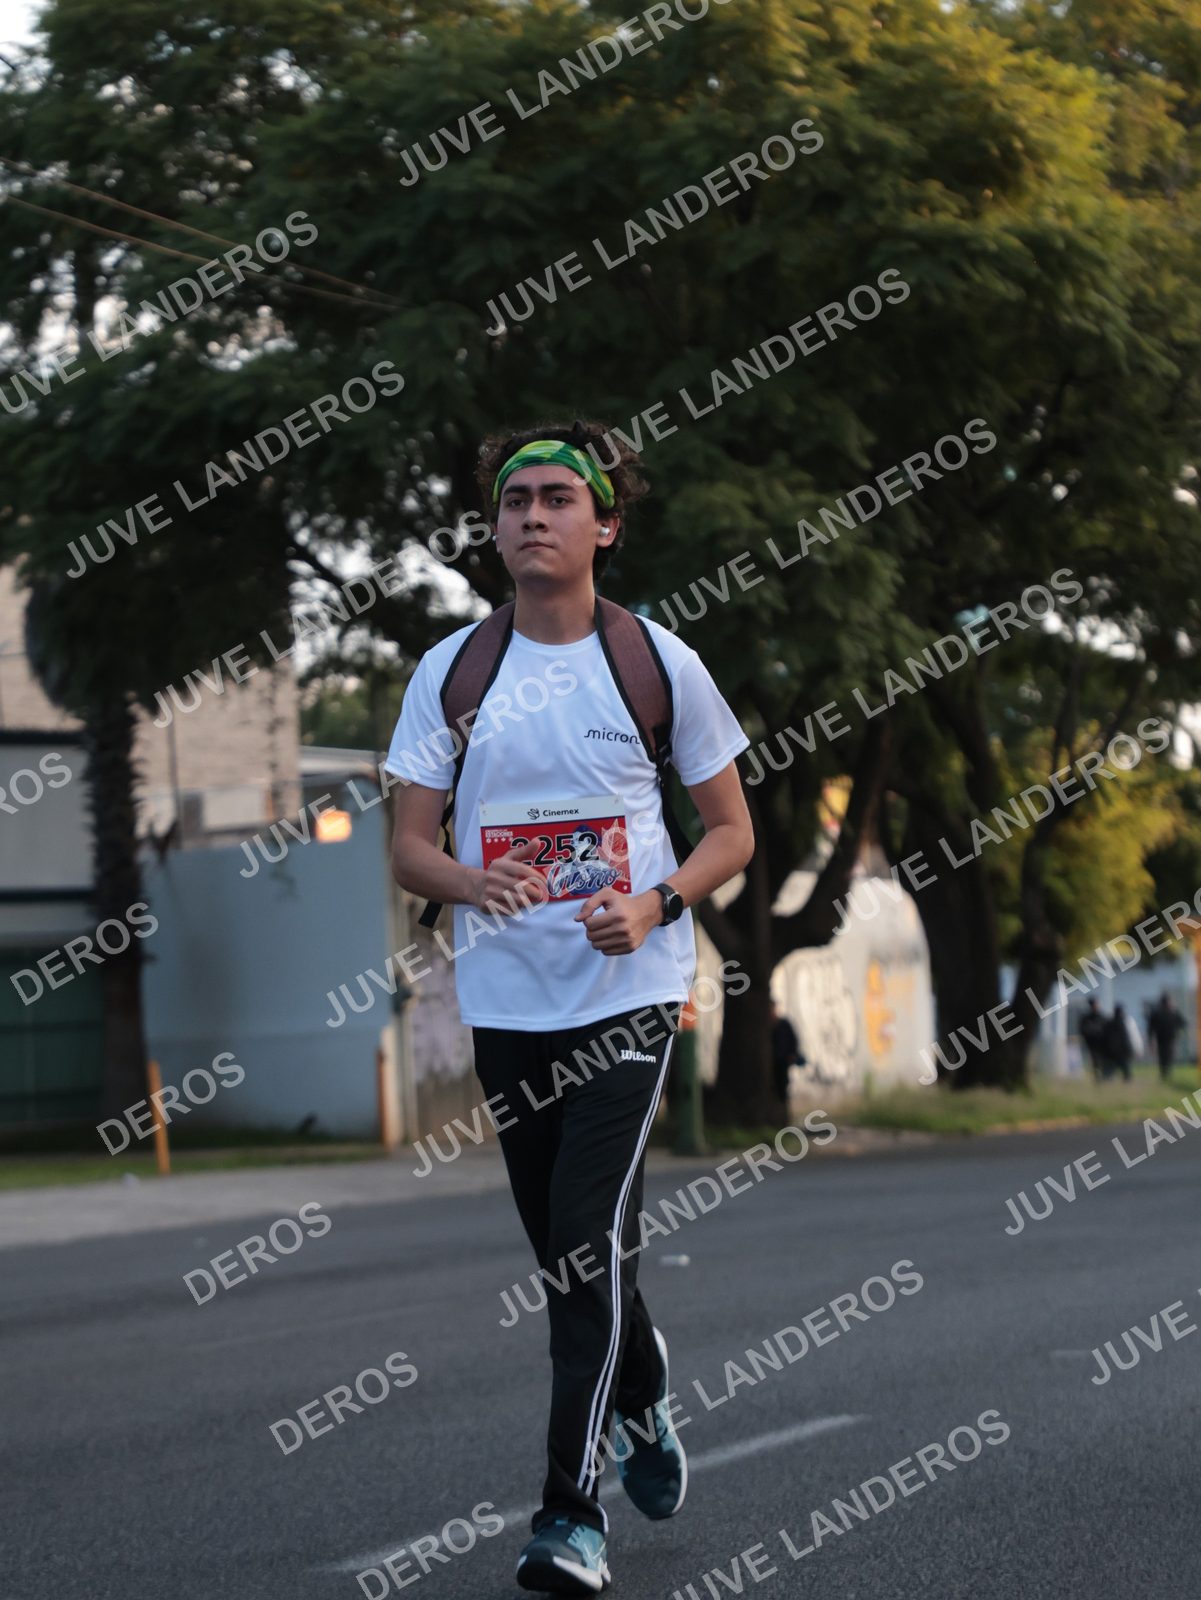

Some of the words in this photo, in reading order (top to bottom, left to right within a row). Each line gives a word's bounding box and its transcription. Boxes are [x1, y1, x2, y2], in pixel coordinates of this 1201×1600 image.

[583, 727, 640, 745] micron
[542, 807, 580, 818] Cinemex
[620, 1049, 657, 1063] Wilson
